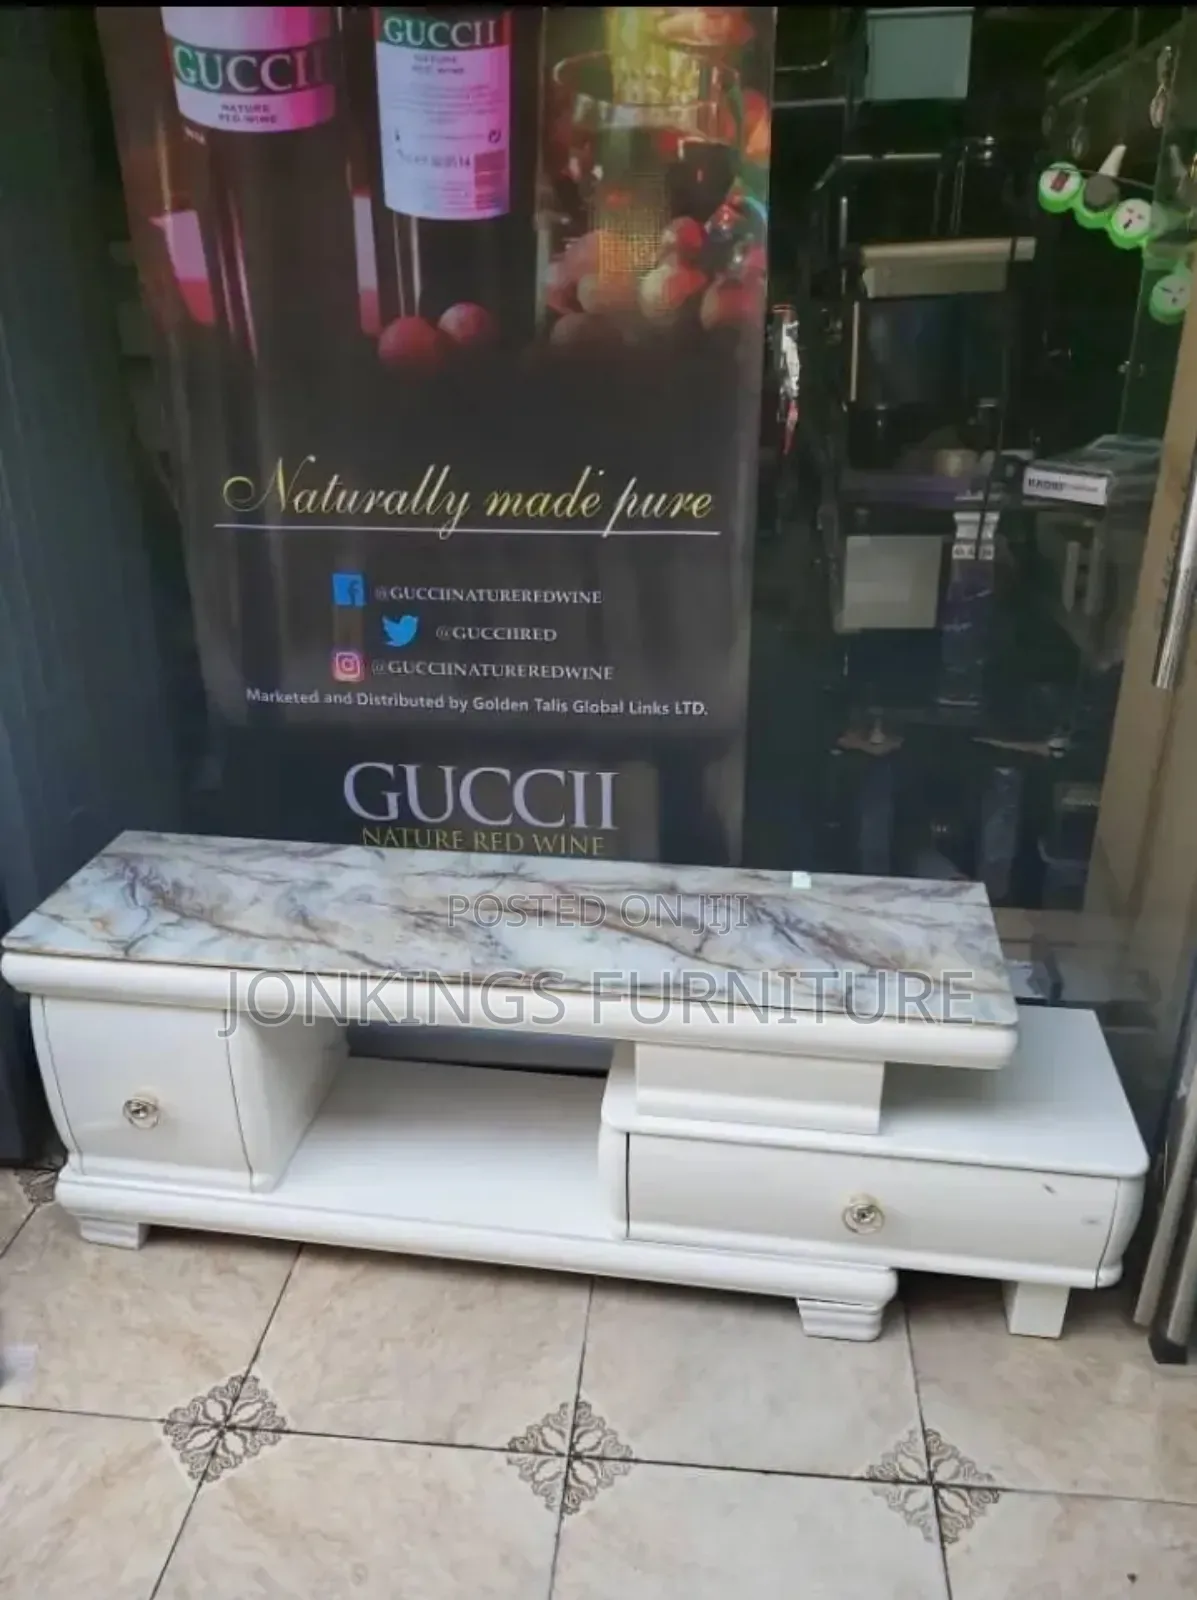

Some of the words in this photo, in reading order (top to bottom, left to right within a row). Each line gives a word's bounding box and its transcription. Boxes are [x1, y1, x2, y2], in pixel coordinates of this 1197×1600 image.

[383, 16, 497, 48] GUCCII
[223, 455, 470, 540] Naturally
[485, 465, 605, 518] made
[602, 476, 713, 538] pure
[246, 688, 319, 704] Marketed
[323, 693, 352, 705] and
[356, 693, 444, 709] Distributed
[449, 696, 468, 713] by
[473, 697, 529, 712] Golden
[535, 698, 569, 713] Talis
[572, 699, 624, 715] Global
[629, 701, 670, 716] Links
[675, 701, 708, 716] LTD.
[343, 762, 619, 830] GUCCII
[362, 827, 464, 850] NATURE
[474, 832, 524, 853] RED
[532, 834, 605, 856] WINE
